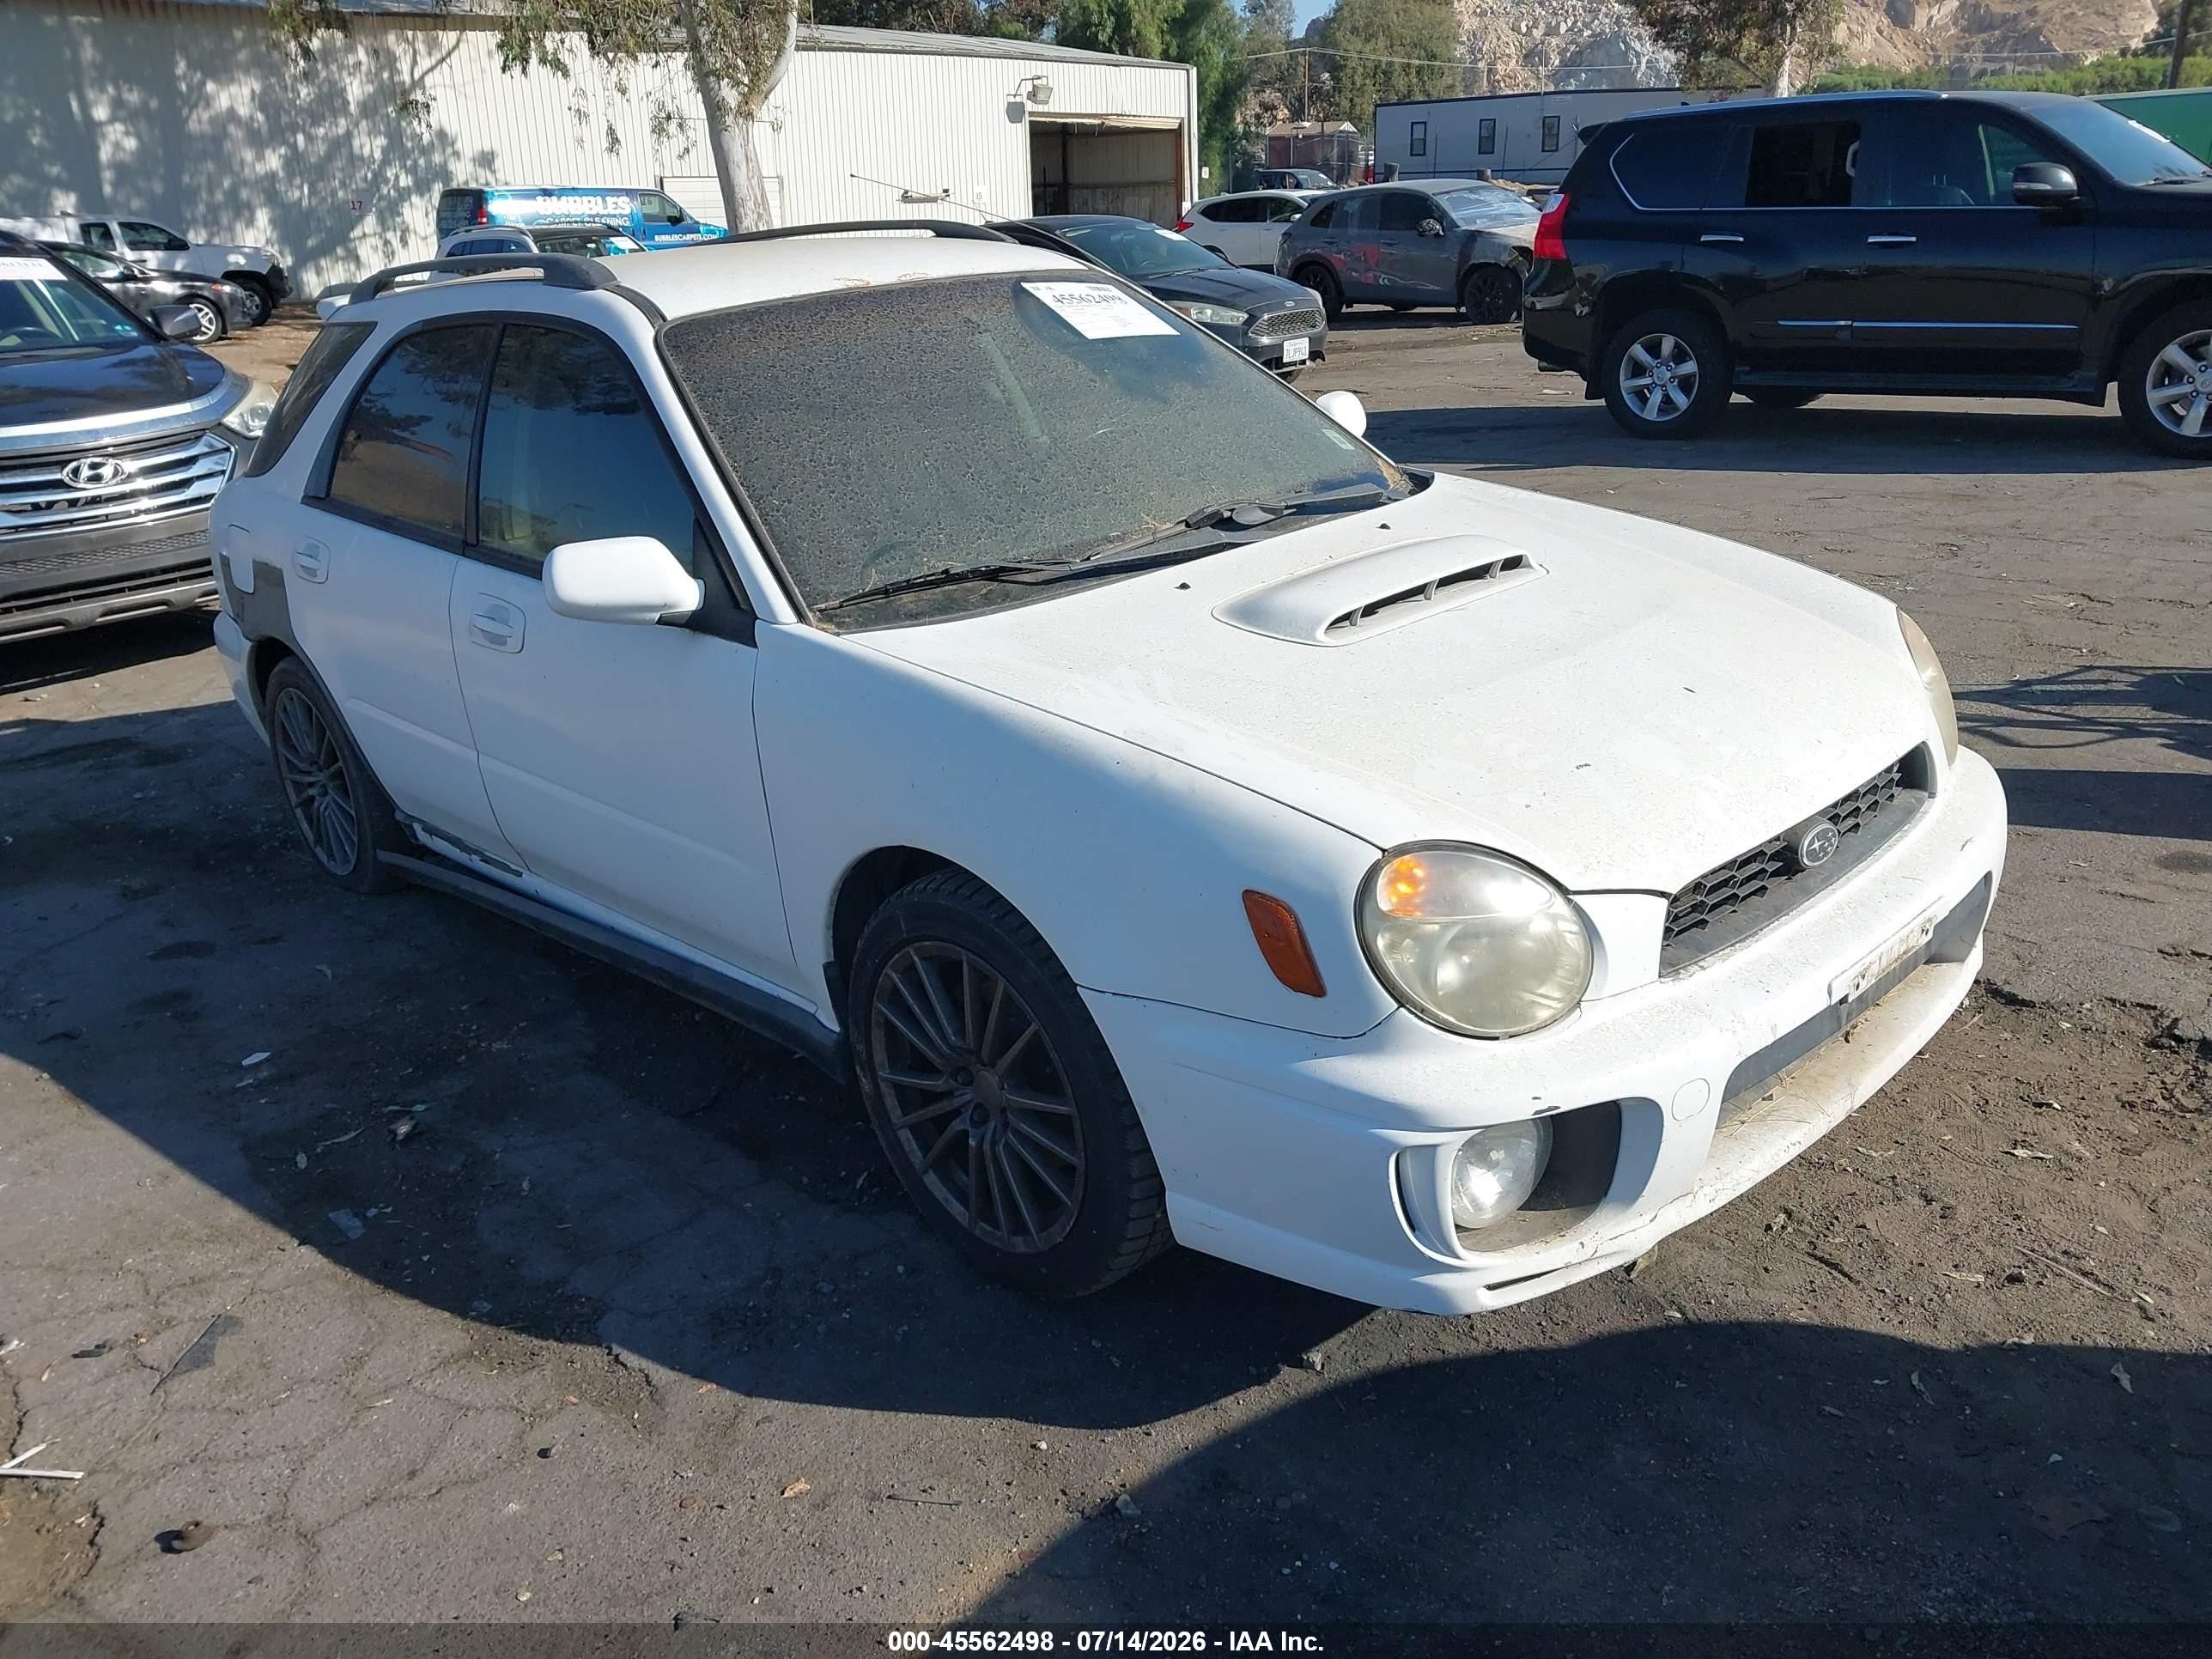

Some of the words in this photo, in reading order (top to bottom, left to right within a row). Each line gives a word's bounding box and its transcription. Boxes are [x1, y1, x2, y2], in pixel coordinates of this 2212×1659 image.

[350, 200, 362, 210] 17
[536, 196, 631, 215] BUBBLES
[583, 216, 630, 227] CLEANING
